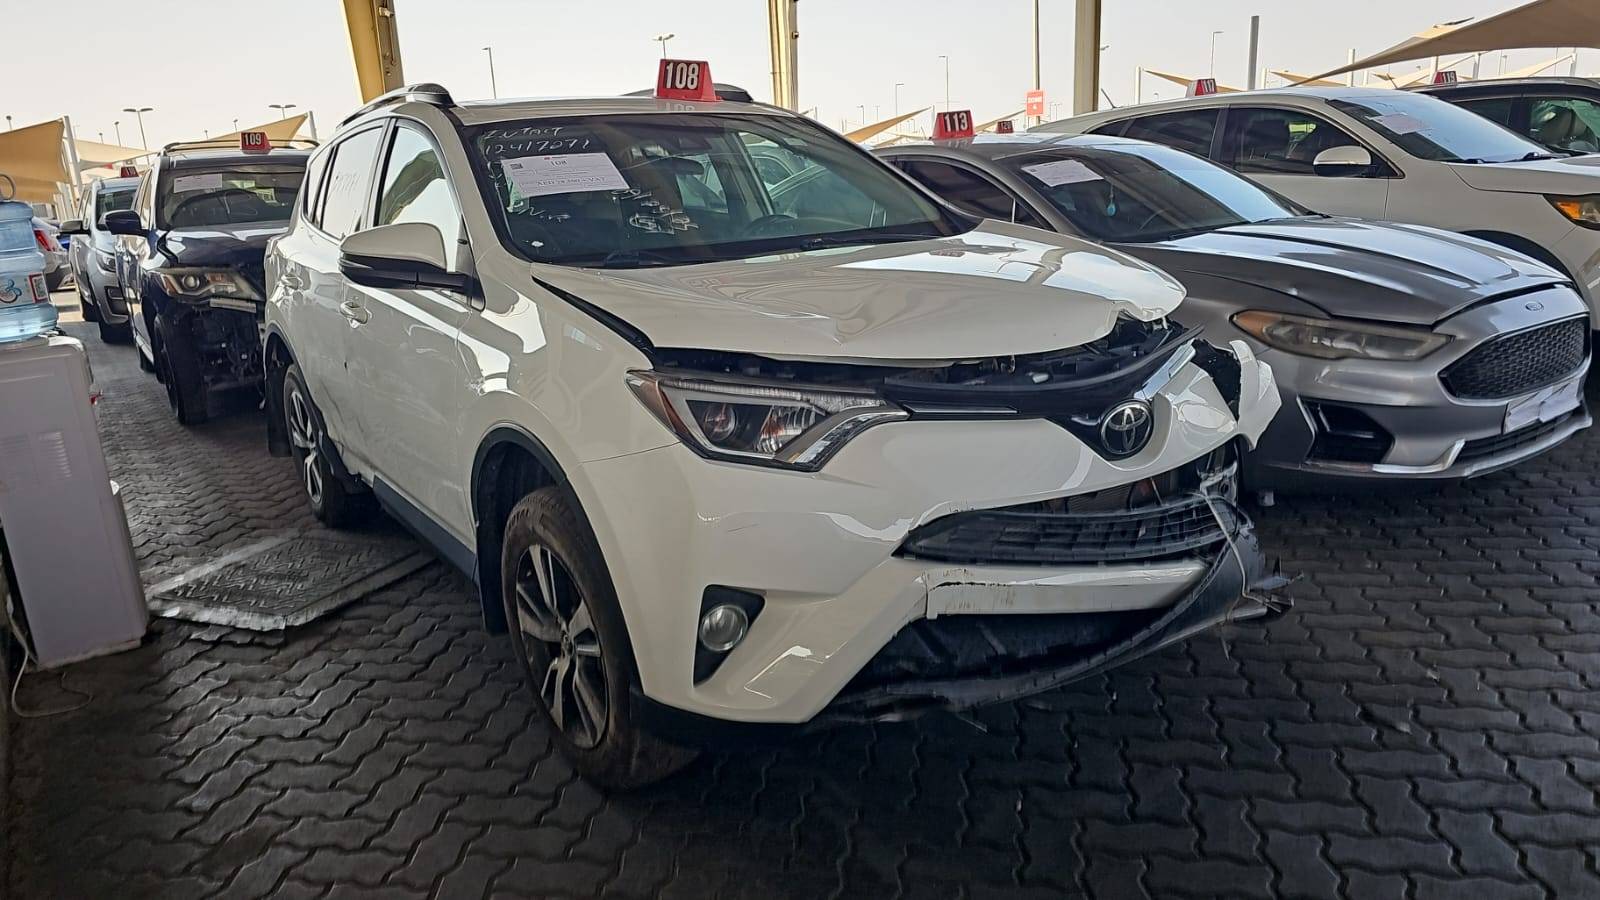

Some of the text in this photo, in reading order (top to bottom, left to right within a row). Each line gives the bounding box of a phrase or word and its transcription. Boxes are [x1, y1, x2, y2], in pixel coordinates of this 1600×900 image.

[666, 62, 699, 90] 108
[944, 112, 968, 132] 113
[244, 133, 262, 146] 109
